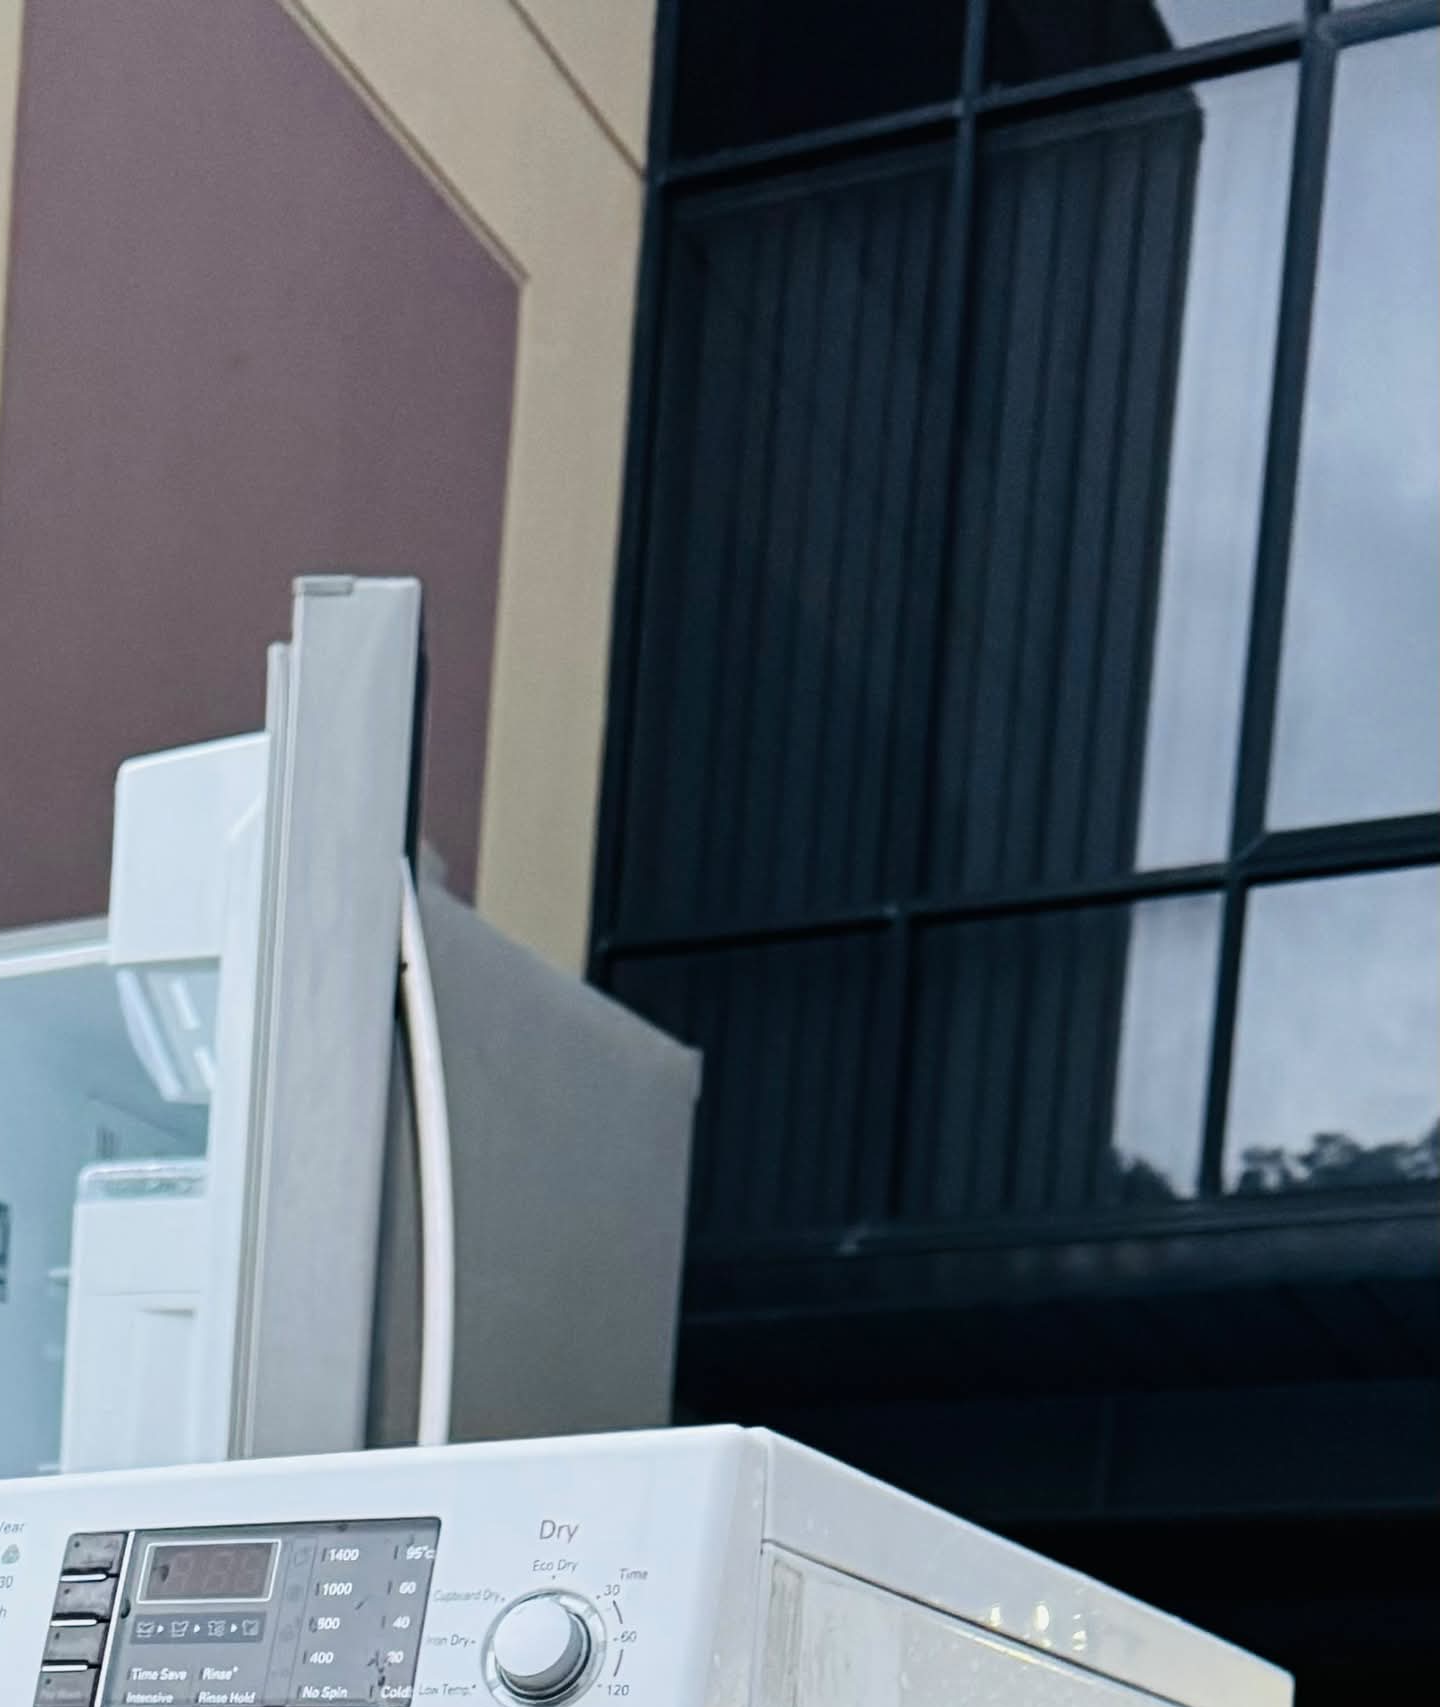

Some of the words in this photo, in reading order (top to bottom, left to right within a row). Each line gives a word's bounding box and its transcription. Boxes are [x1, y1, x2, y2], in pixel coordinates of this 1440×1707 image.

[539, 1519, 580, 1544] Dry
[329, 1548, 360, 1561] 1400
[532, 1559, 554, 1572] Eco
[557, 1558, 579, 1573] Dry
[619, 1568, 649, 1581] Time
[322, 1582, 353, 1596] 1000
[603, 1584, 621, 1597] 30
[392, 1615, 411, 1629] 40
[620, 1630, 637, 1643] 60
[309, 1651, 335, 1664] 400
[131, 1667, 159, 1681] Time
[160, 1667, 188, 1681] Save
[198, 1690, 228, 1704] Rinse
[229, 1690, 256, 1704] Hold
[302, 1685, 320, 1699] No
[320, 1685, 348, 1700] Spin
[380, 1685, 413, 1699] Cold
[607, 1683, 630, 1697] 120
[126, 1691, 174, 1704] Intensive
